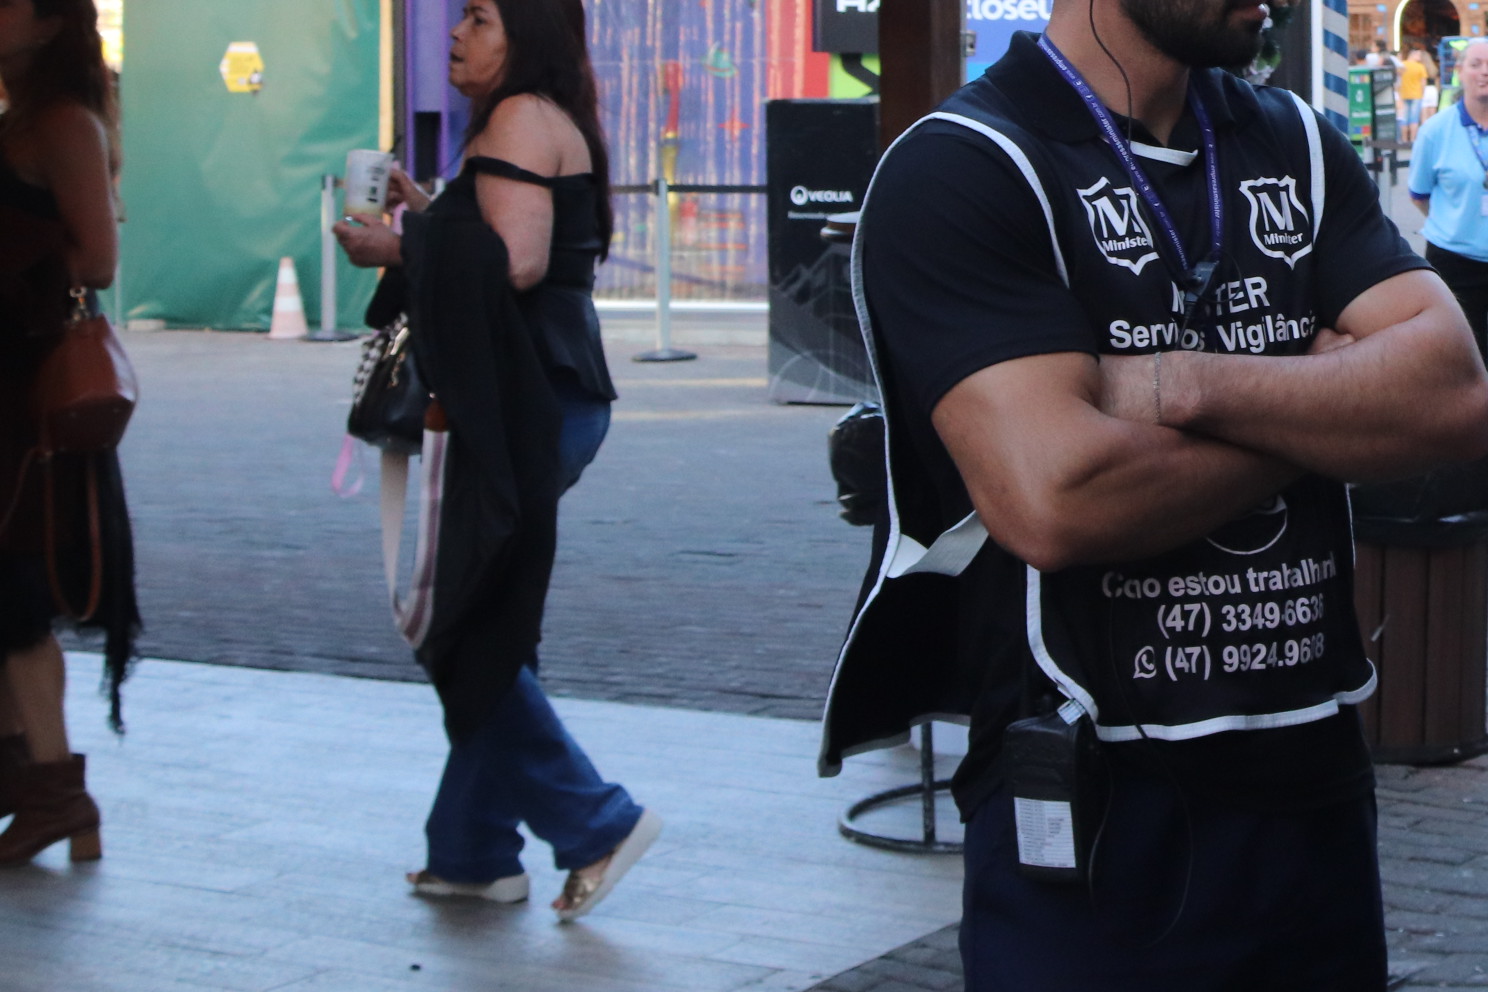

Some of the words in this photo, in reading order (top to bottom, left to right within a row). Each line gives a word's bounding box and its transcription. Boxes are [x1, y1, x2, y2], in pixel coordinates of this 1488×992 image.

[807, 190, 854, 203] VEOLIA
[1101, 236, 1149, 253] Ministe
[1168, 570, 1242, 597] estou
[1157, 601, 1212, 640] (47)
[1165, 644, 1212, 682] (47)
